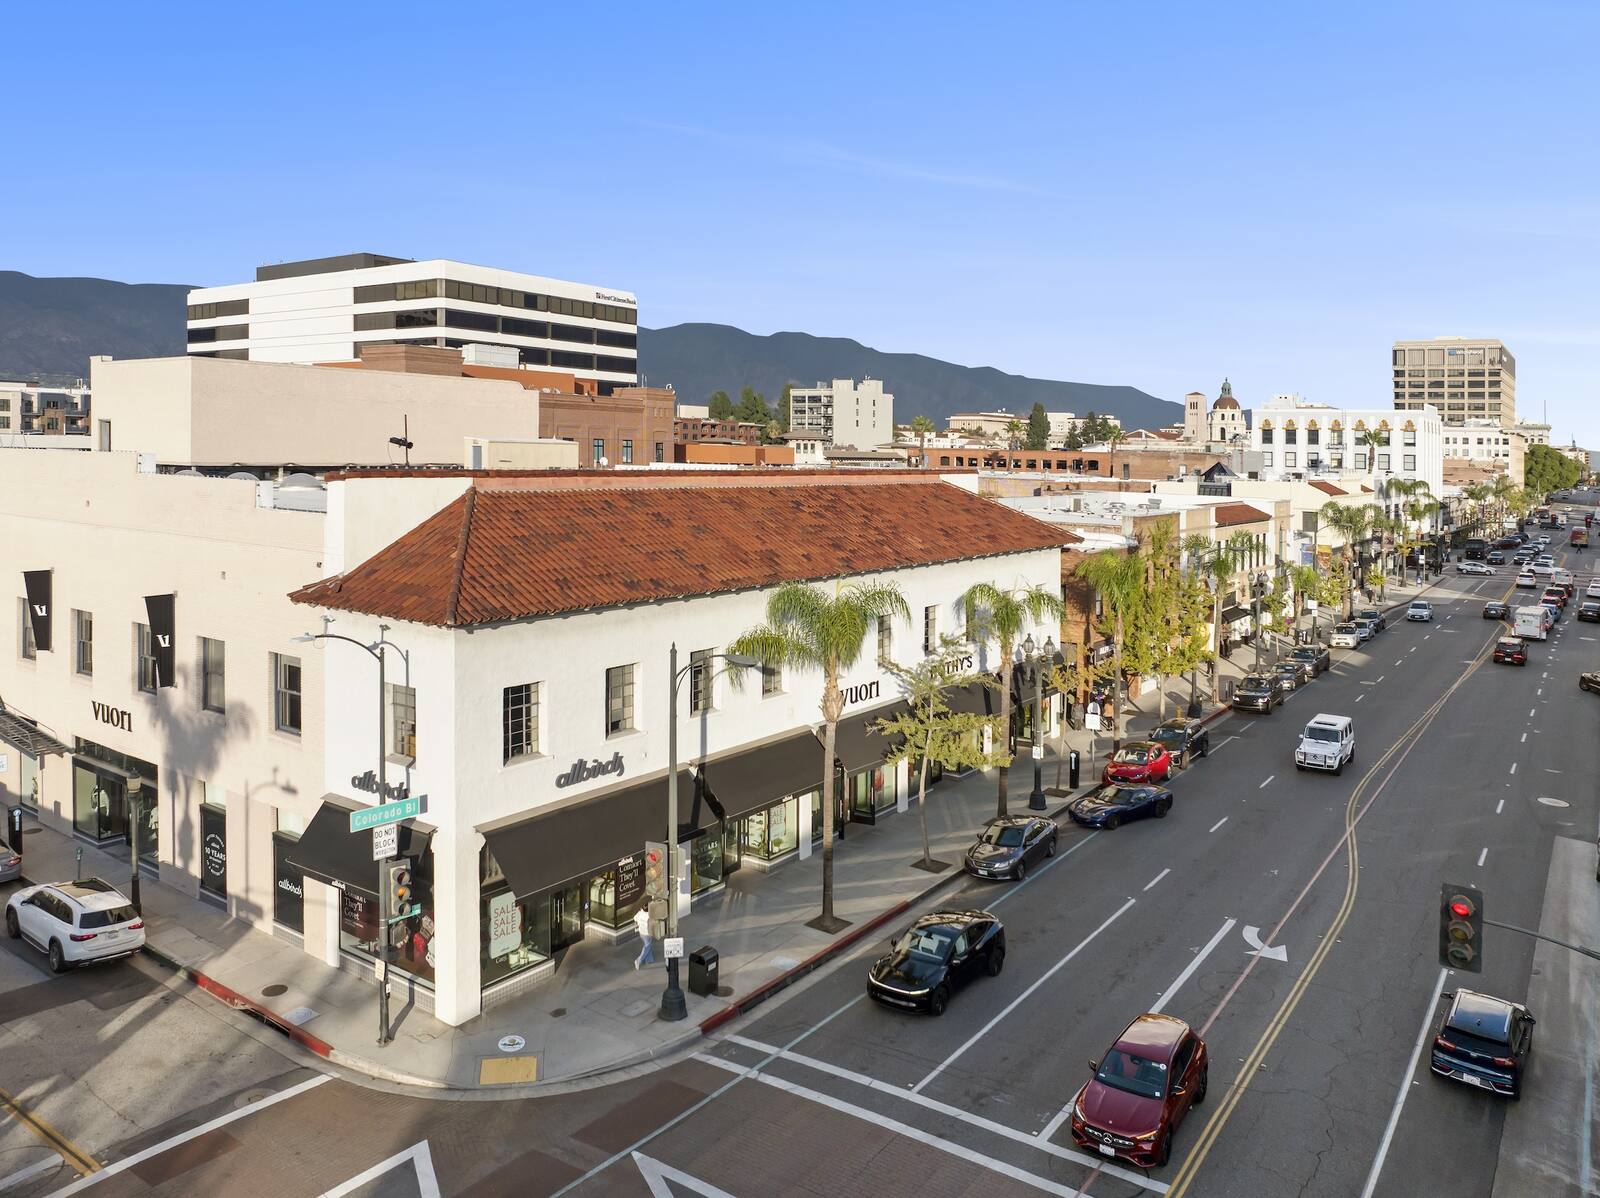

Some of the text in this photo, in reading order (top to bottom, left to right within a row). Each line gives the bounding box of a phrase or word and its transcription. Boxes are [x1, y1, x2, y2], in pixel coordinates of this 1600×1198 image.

[91, 700, 133, 733] vuori
[555, 752, 625, 789] allbirds
[354, 807, 402, 826] Colorado
[374, 827, 395, 839] DO NOT
[375, 839, 396, 849] BLOCK
[211, 849, 226, 861] YEARS
[278, 879, 303, 898] allbirds
[493, 902, 517, 919] SALE
[493, 912, 517, 930] SALE
[493, 923, 517, 941] SALE
